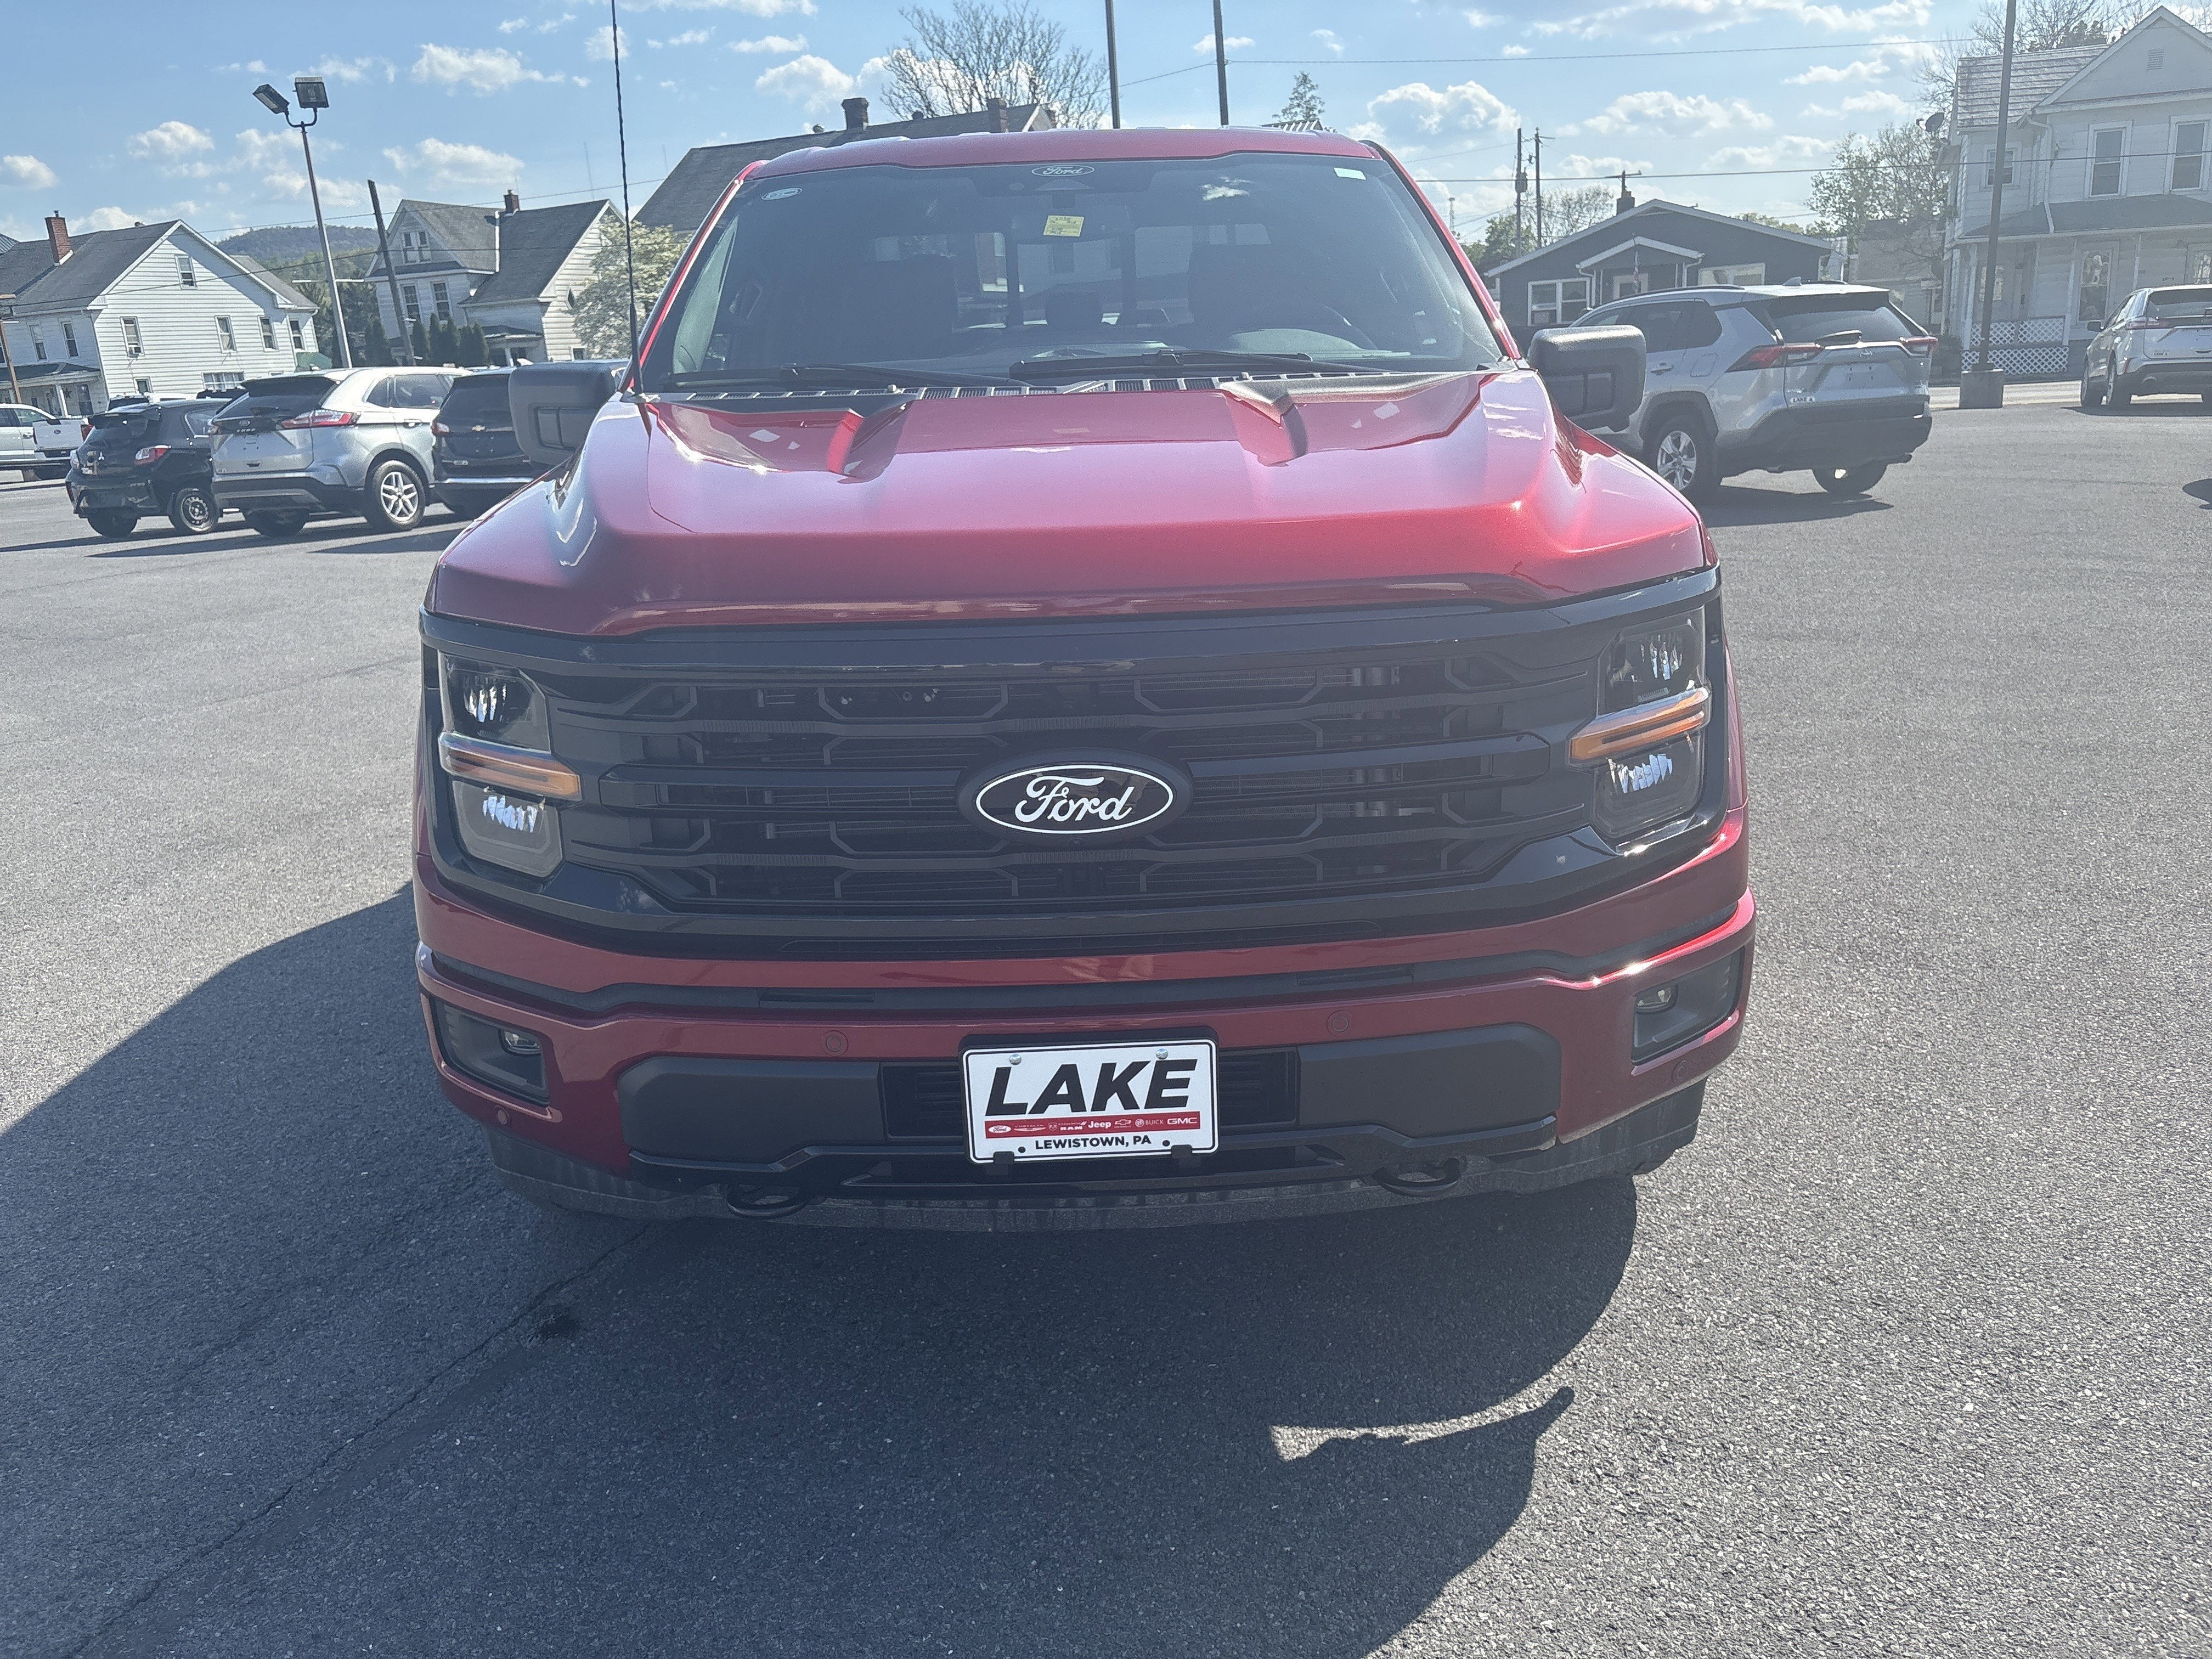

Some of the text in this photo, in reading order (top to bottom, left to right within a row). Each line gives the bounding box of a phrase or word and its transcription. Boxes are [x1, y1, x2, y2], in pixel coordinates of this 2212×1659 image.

[1042, 166, 1084, 174] Ford
[1014, 775, 1135, 822] Ford
[985, 1058, 1198, 1116] LAKE
[1035, 1135, 1152, 1149] LEWISTOWN, PA
